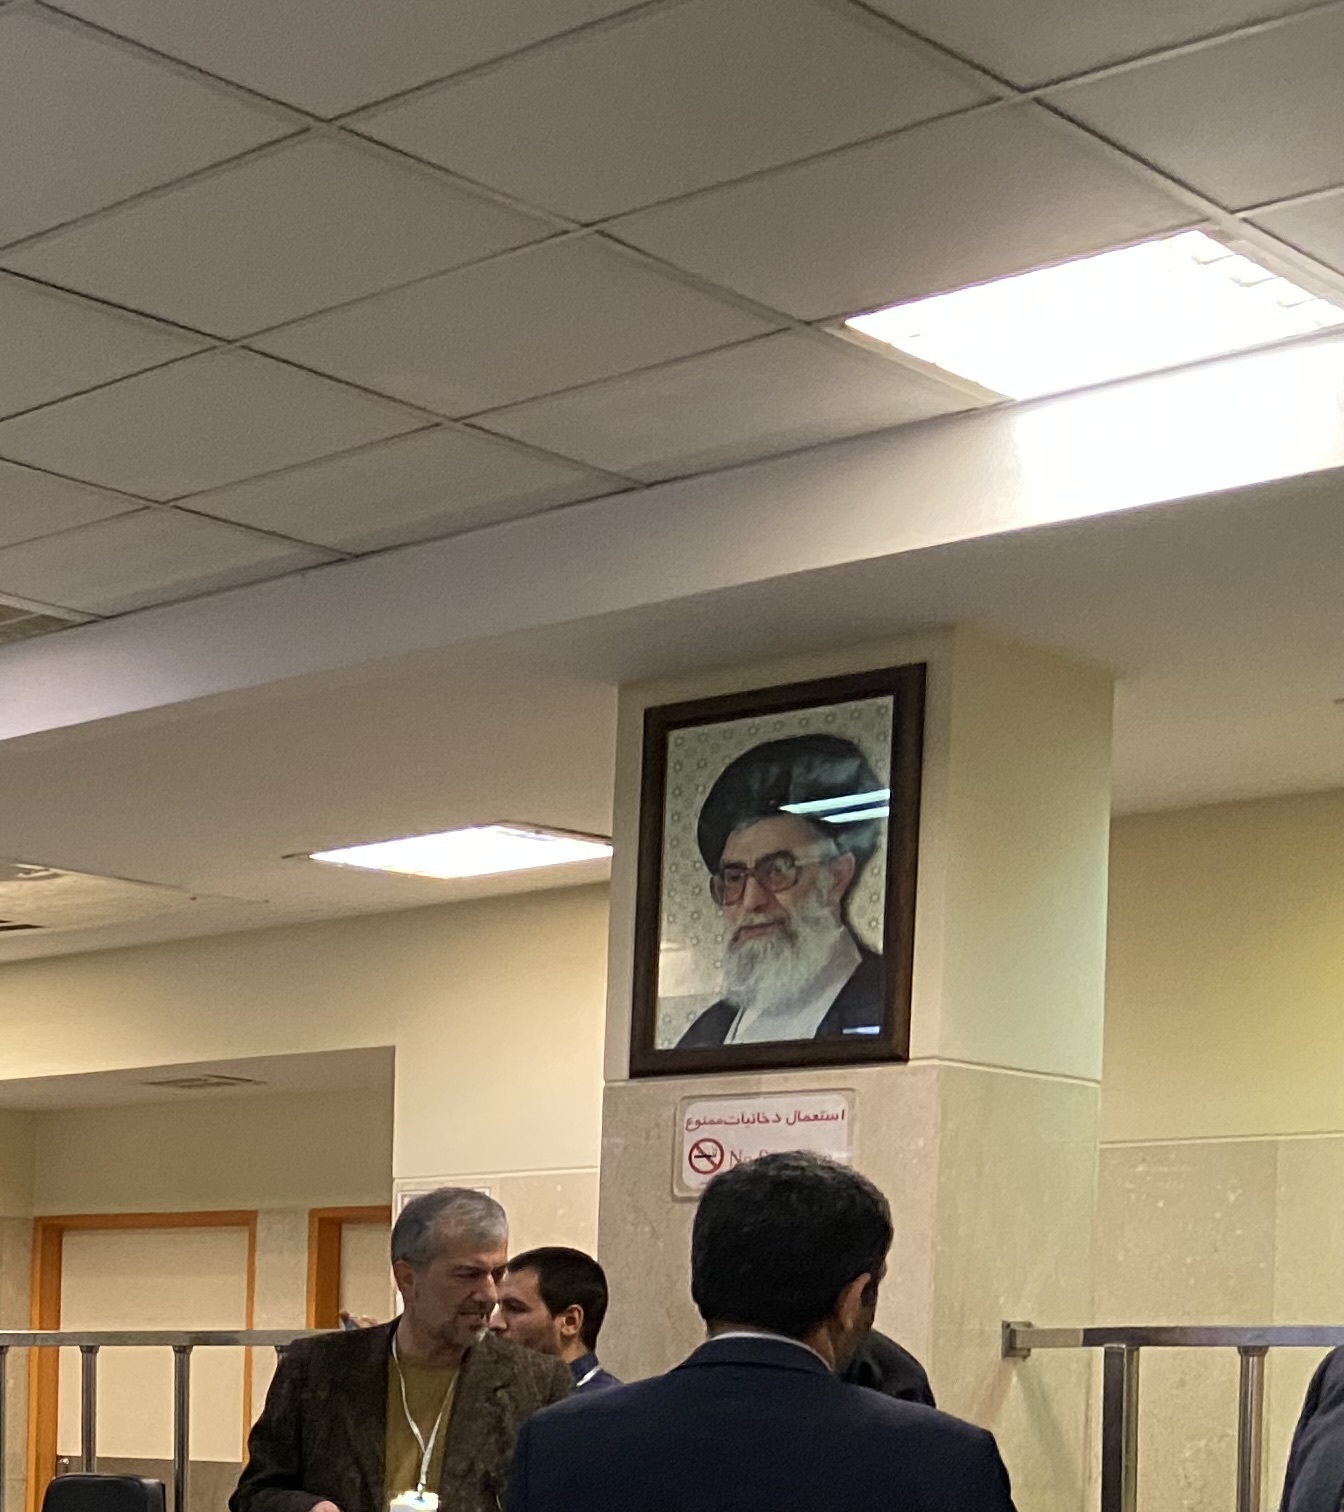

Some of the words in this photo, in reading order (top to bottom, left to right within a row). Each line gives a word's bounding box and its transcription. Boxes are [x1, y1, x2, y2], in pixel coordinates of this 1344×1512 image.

[685, 1115, 725, 1132] ممنوع
[723, 1111, 781, 1128] دخانیات
[785, 1108, 845, 1126] استعمال
